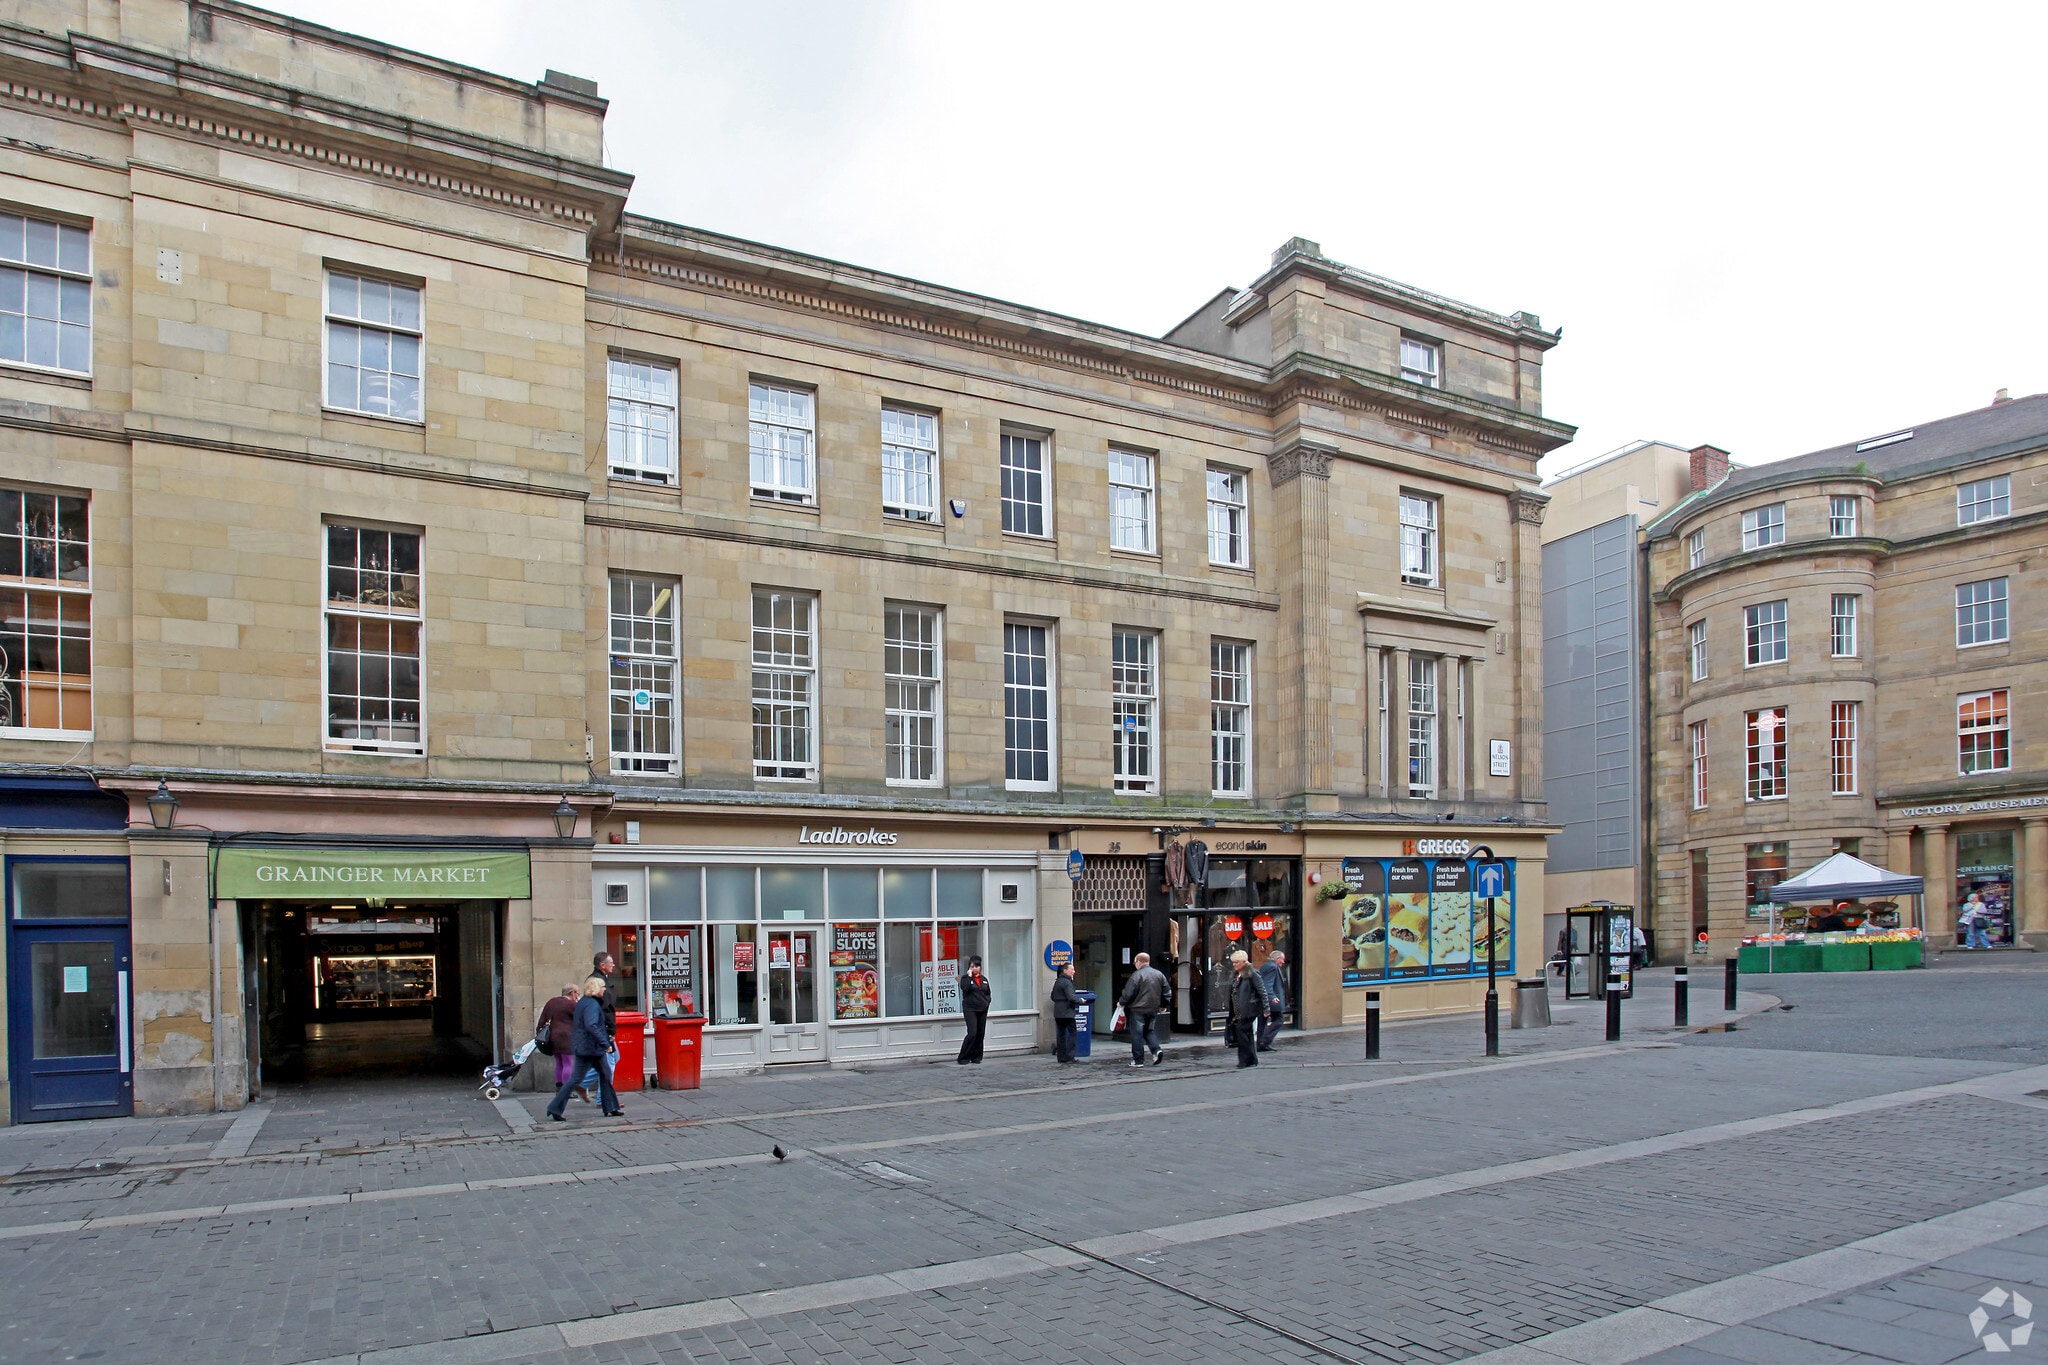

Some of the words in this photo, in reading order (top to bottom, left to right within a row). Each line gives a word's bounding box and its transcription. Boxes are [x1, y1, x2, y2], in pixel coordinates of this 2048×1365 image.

[1902, 803, 1962, 816] VICTORY
[799, 825, 898, 845] Ladbrokes
[1215, 839, 1245, 850] econd
[1245, 839, 1267, 851] skin
[1417, 838, 1470, 855] GREGGS
[256, 866, 385, 882] GRAINGER
[393, 867, 490, 883] MARKET
[1960, 864, 2009, 873] ENTRANCE
[1344, 874, 1364, 882] ground
[1225, 922, 1242, 932] SALE
[1252, 921, 1273, 931] SALE
[650, 935, 690, 954] WIN
[836, 938, 876, 950] SLOTS
[650, 954, 690, 970] FREE
